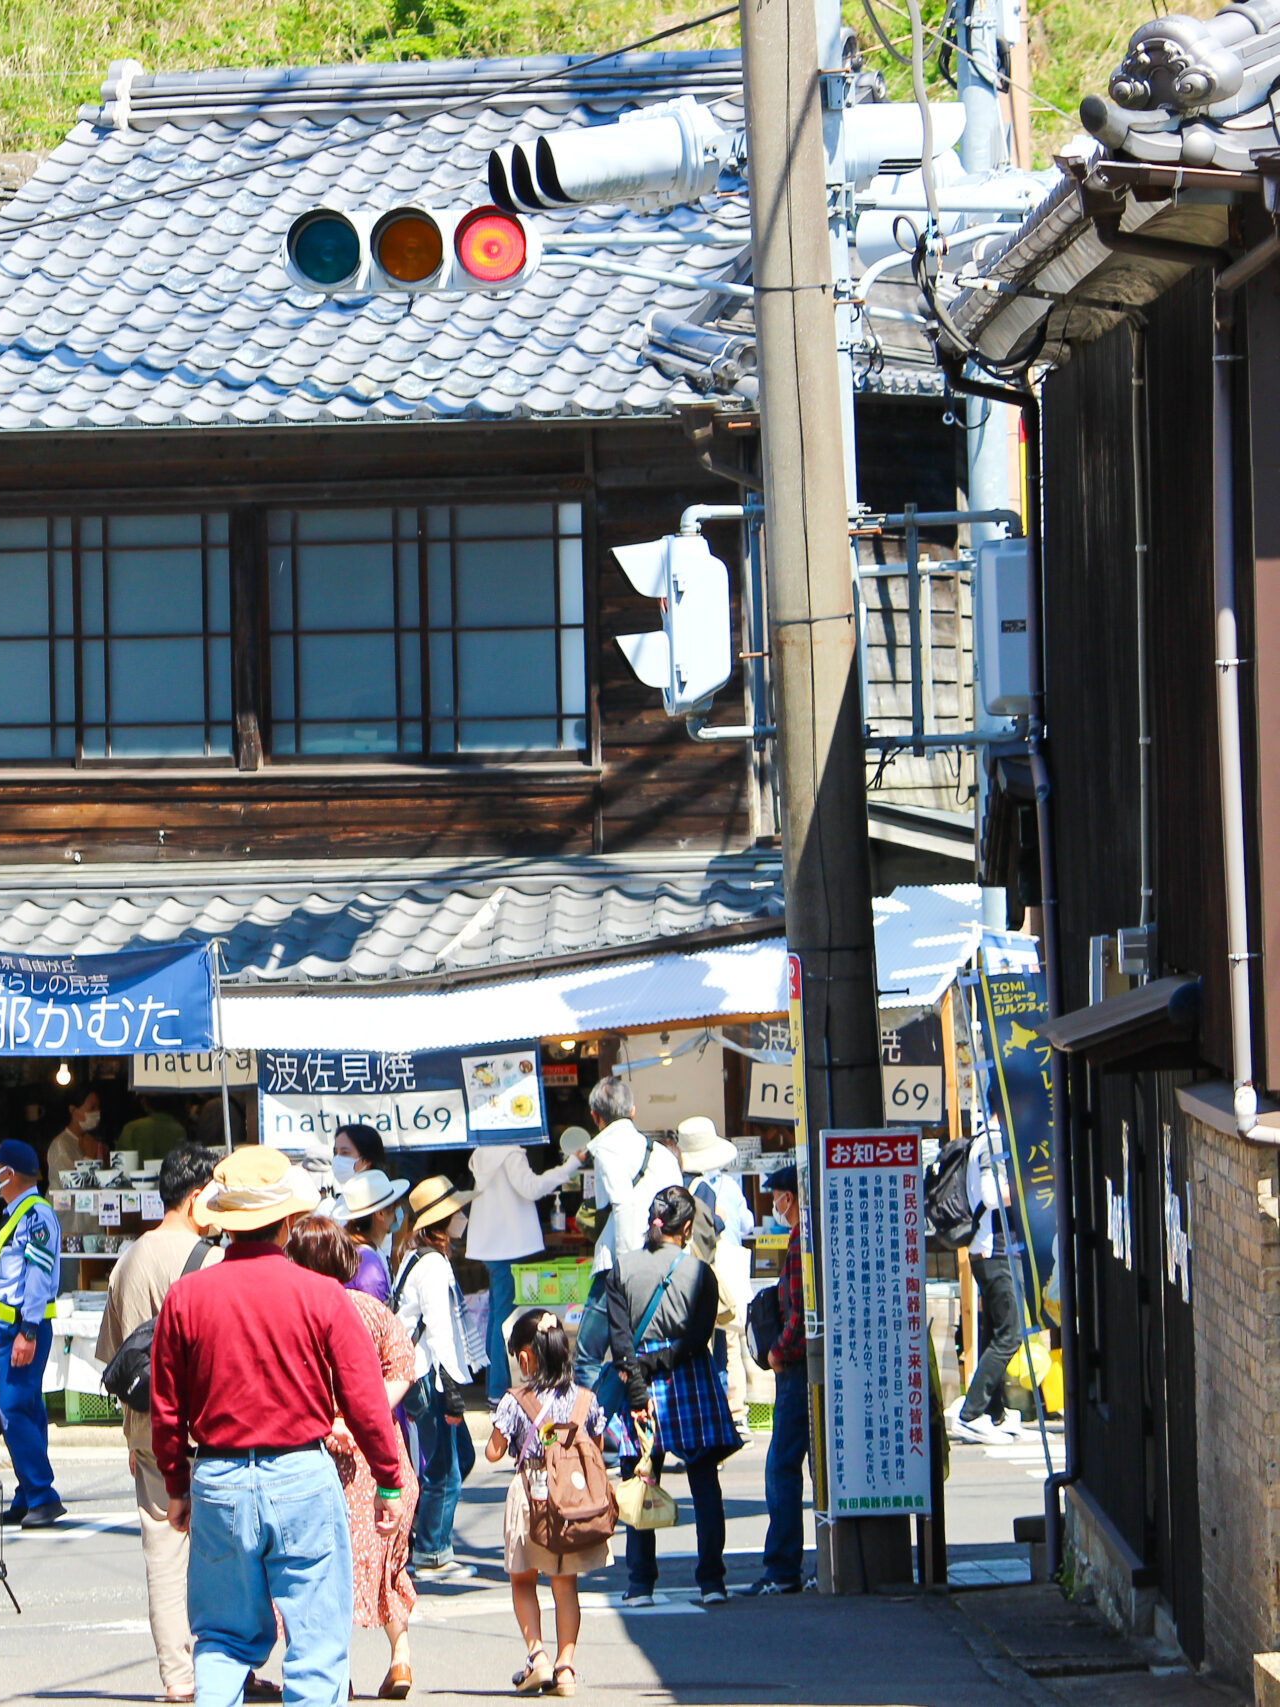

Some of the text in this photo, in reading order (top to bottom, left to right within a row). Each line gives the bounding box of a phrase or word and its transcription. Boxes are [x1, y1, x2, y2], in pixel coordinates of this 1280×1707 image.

[18, 957, 77, 973] 自由が丘
[990, 981, 1026, 994] TOMI
[993, 1001, 1049, 1016] シルクアイ
[265, 1052, 417, 1092] 波佐見焼
[275, 1104, 452, 1133] natural69
[831, 1141, 914, 1165] お知らせ
[1027, 1140, 1055, 1210] バニラ
[902, 1173, 925, 1457] 町民の皆様・陶器市ご来場の皆様へ
[837, 1494, 925, 1511] 有田陶器市委員会
